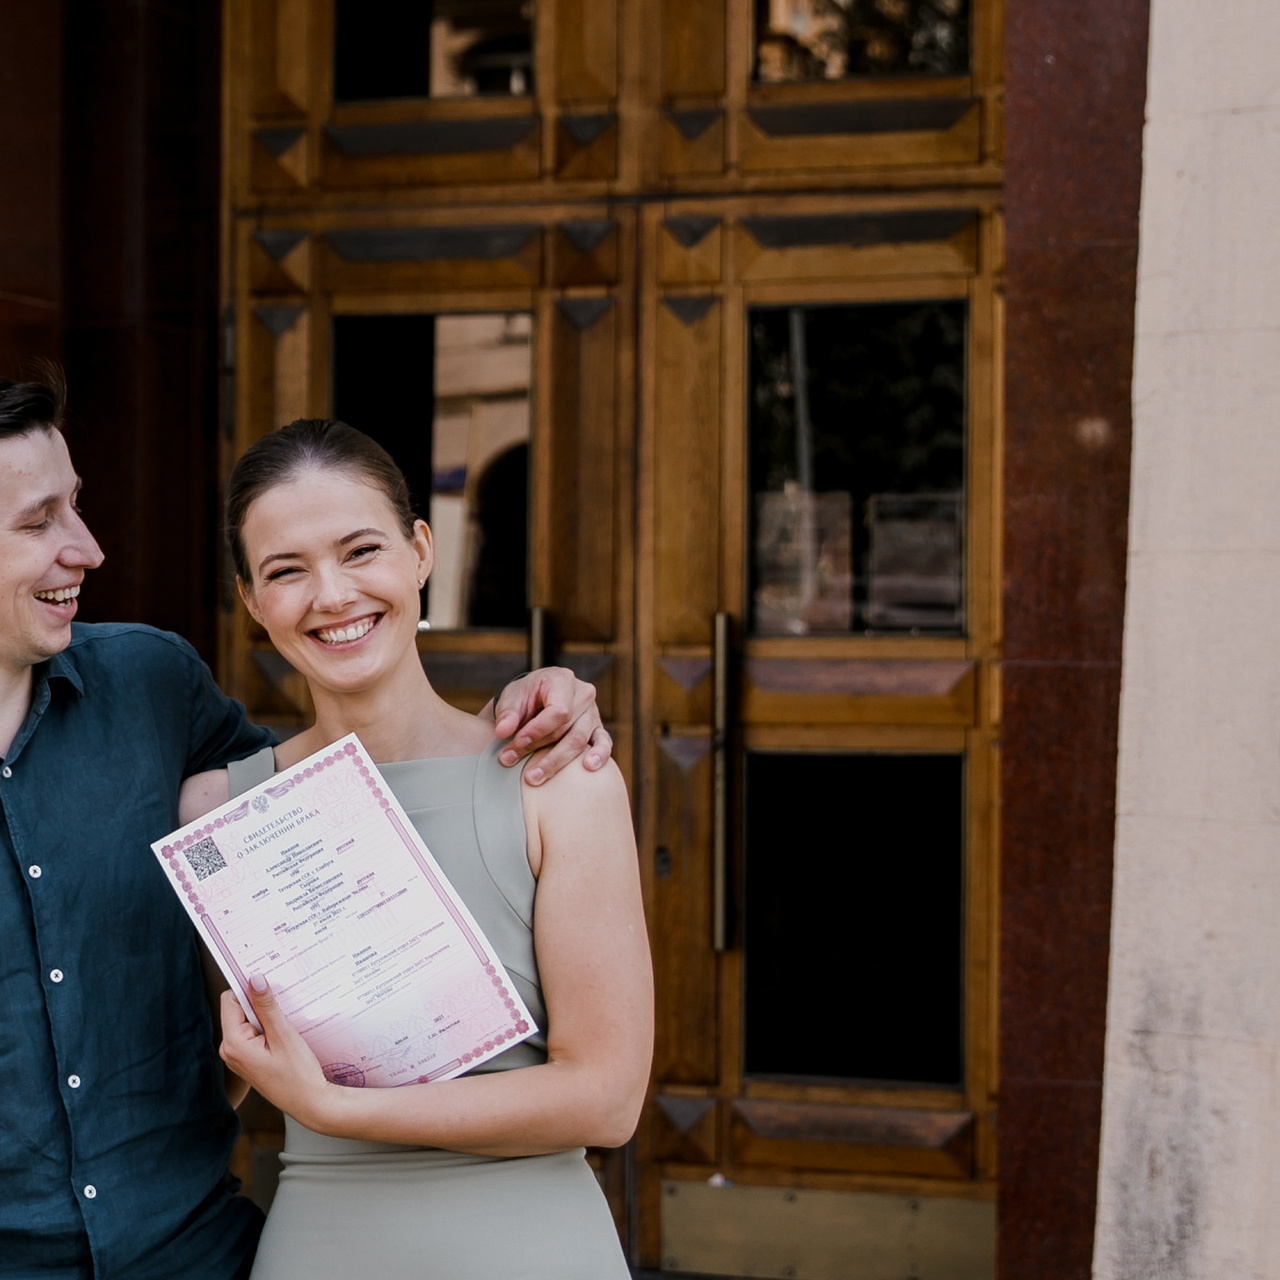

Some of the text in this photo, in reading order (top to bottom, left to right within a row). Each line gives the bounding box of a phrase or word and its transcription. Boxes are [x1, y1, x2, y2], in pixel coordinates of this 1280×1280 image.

[243, 806, 304, 845] СВИДЕТЕЛЬСТВО
[244, 822, 296, 856] ЗАКЛЮЧЕНИИ
[296, 808, 320, 826] БРАКА
[265, 856, 292, 874] Александр
[292, 838, 323, 858] Николаевич
[272, 861, 298, 879] Российская
